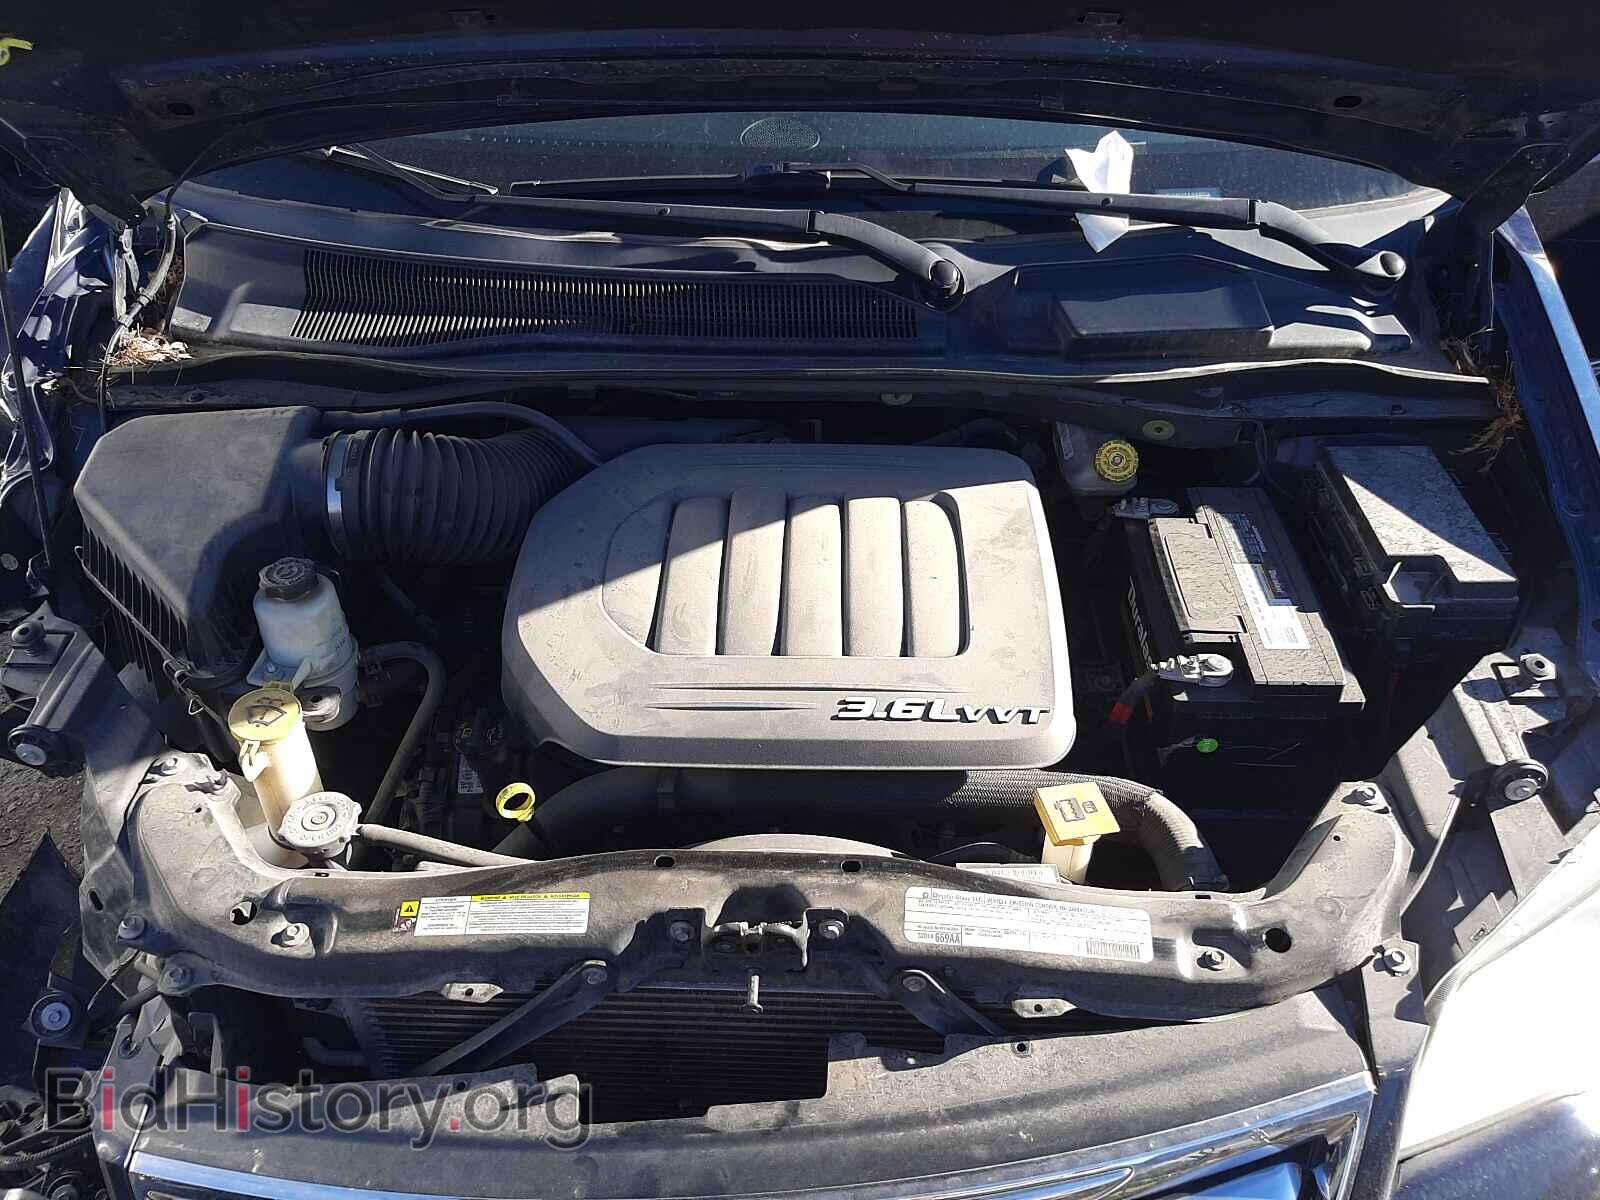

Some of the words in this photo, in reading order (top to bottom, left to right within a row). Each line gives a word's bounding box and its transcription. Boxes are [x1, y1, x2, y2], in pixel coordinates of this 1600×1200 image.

[831, 696, 961, 722] 3.6L
[956, 706, 1050, 724] VVT
[935, 932, 960, 945] 669AA
